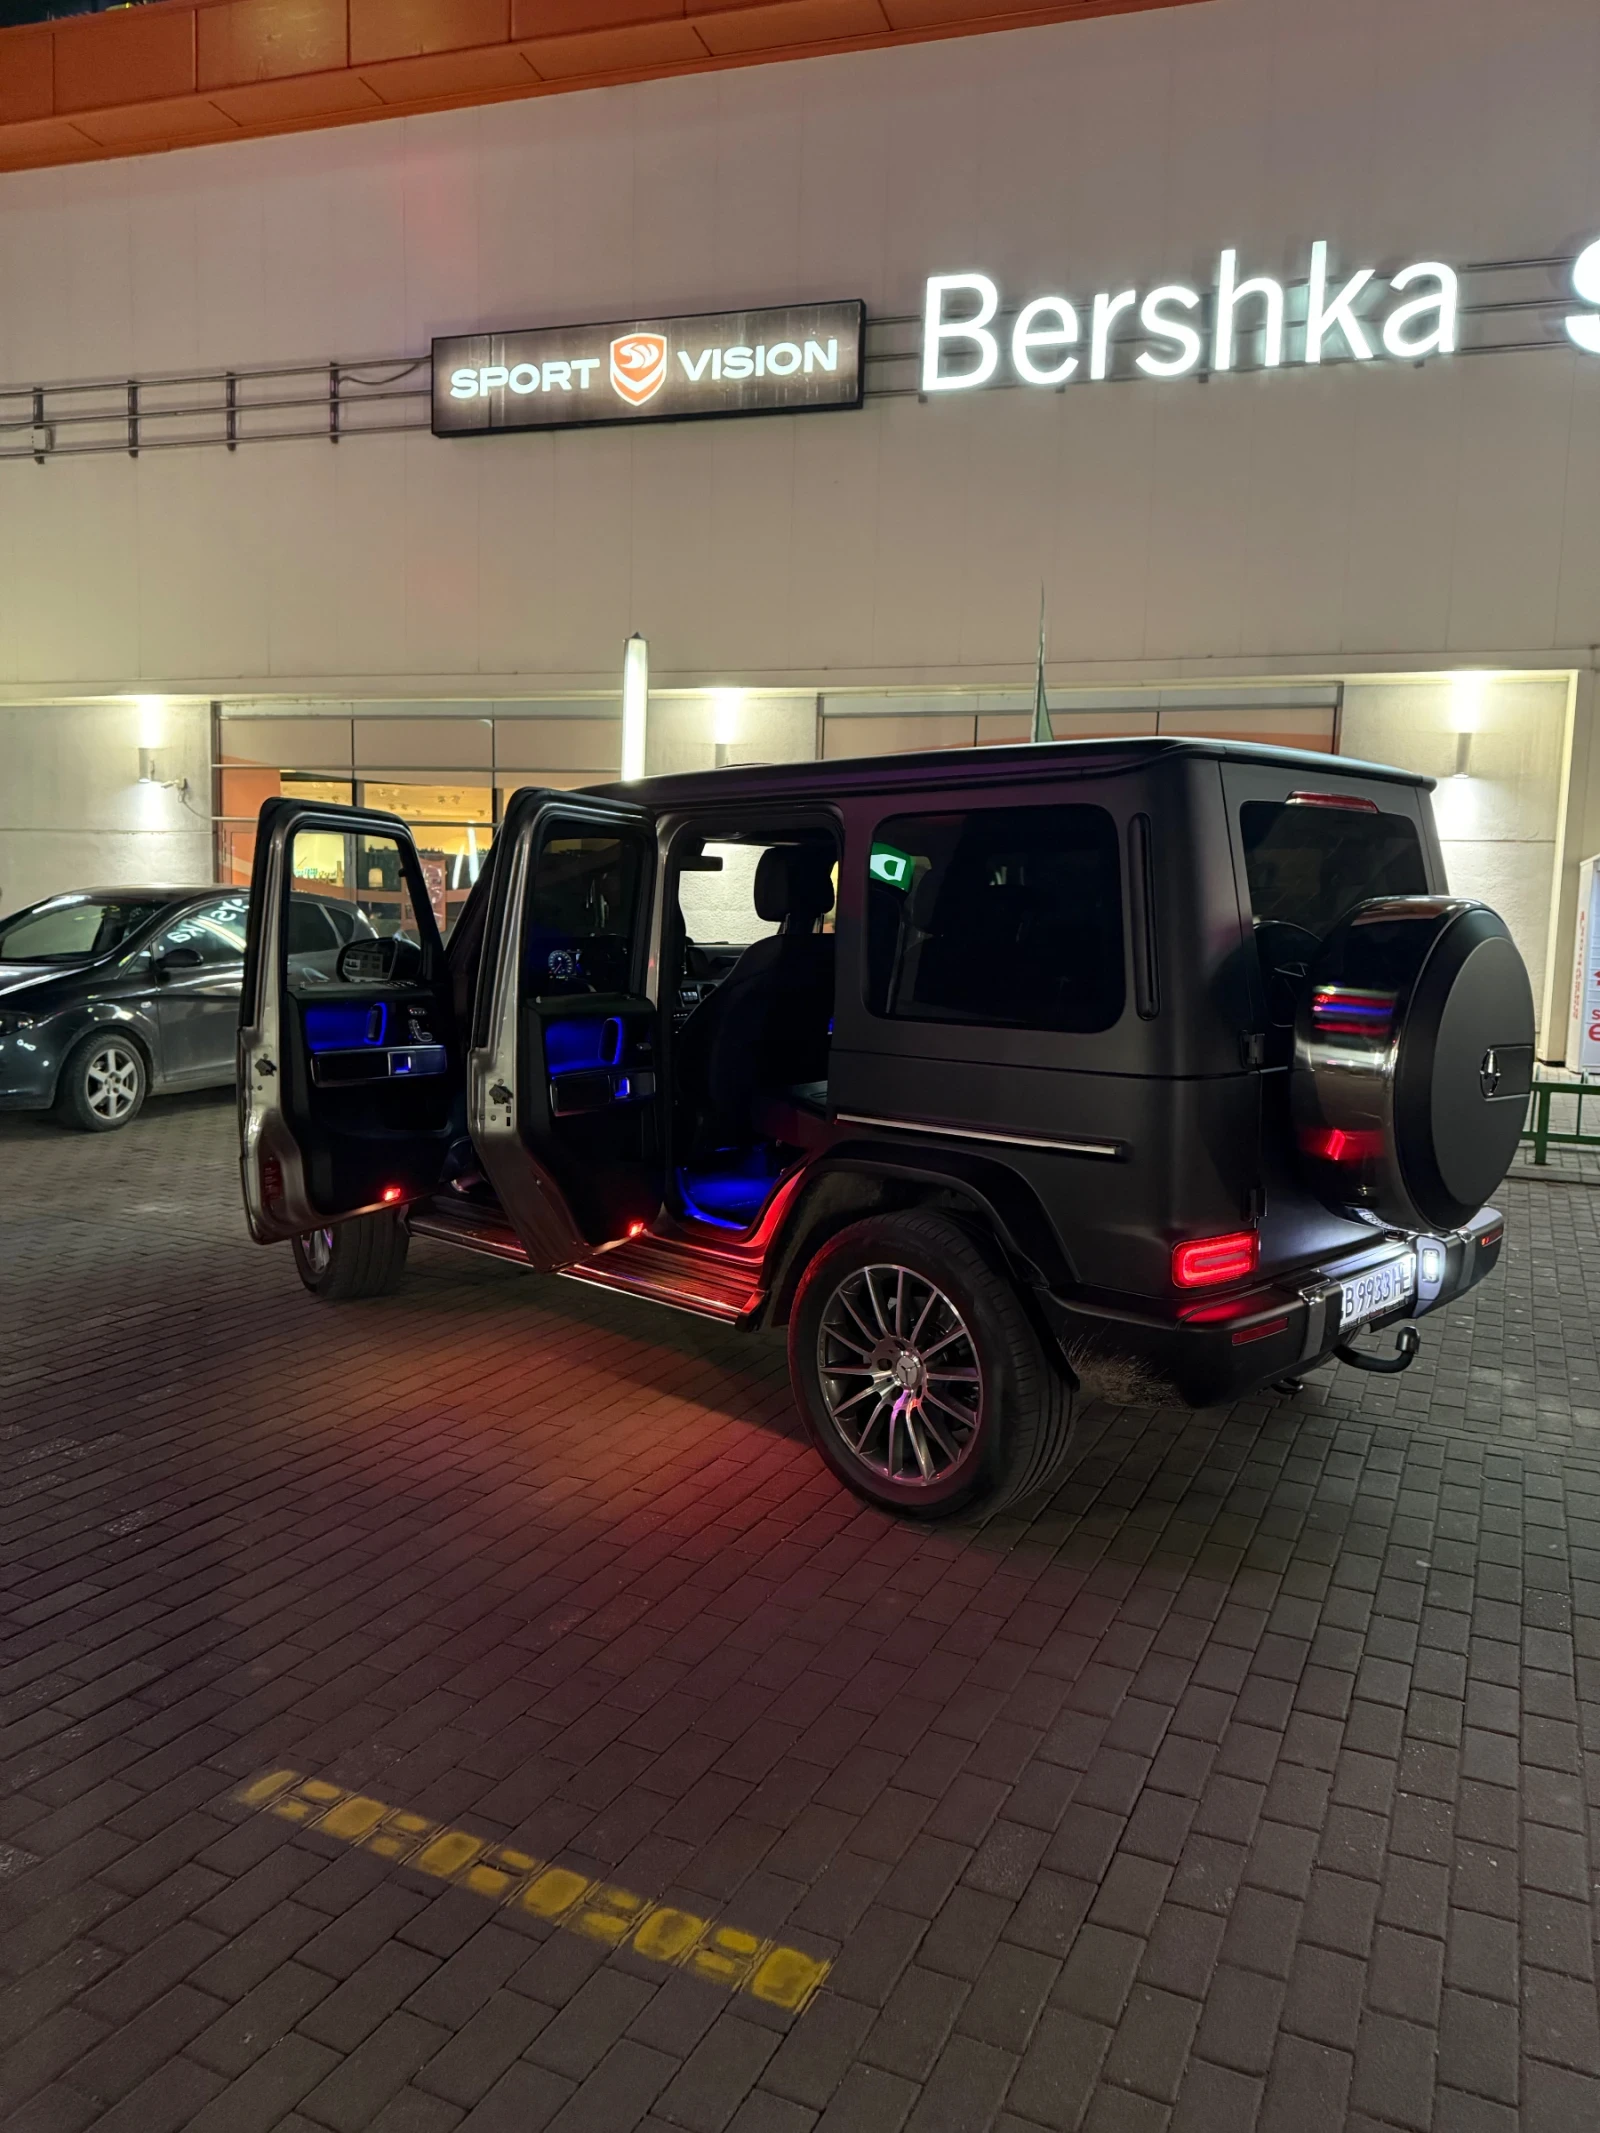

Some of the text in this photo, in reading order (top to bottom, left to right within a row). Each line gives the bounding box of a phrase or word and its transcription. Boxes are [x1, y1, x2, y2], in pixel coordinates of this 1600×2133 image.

[922, 239, 1459, 392] Bershka
[449, 338, 839, 400] SPORT VISION
[1356, 1269, 1391, 1314] 9933
